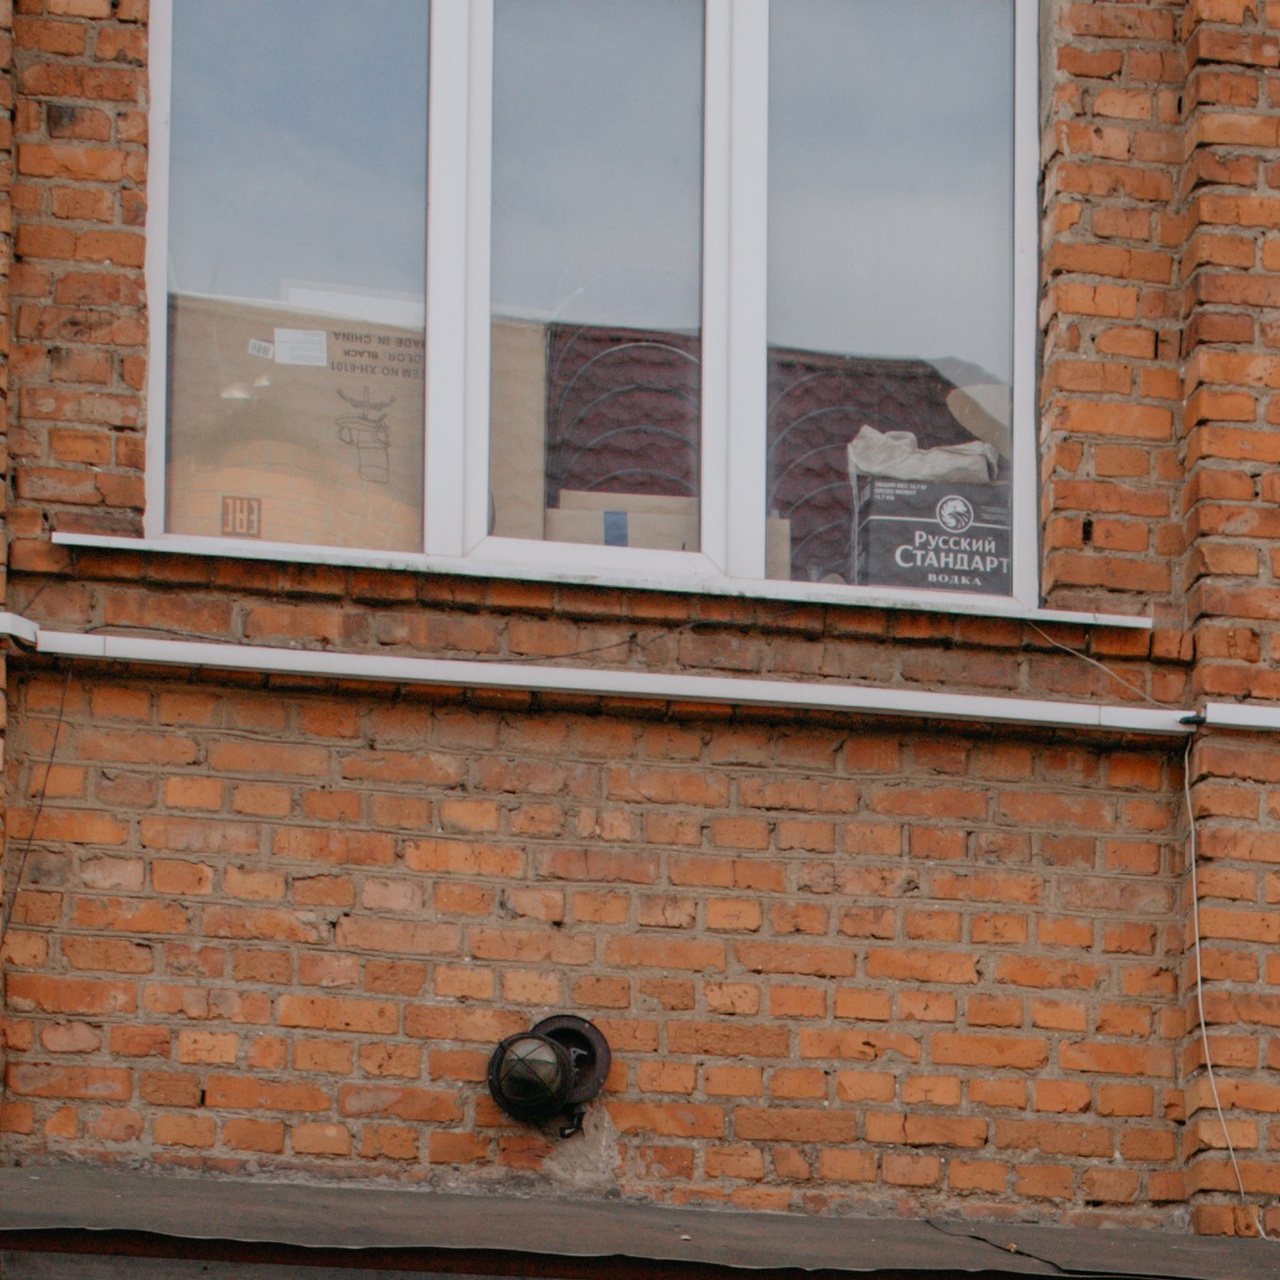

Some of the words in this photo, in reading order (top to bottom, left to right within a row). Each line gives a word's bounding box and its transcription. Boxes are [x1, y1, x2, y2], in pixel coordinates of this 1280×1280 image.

[332, 331, 372, 345] CHINA
[377, 335, 390, 346] IN
[395, 337, 425, 349] ADE
[343, 348, 379, 360] BLACK
[894, 544, 1010, 574] СТАНДАРТ
[927, 573, 982, 586] ВОДКА
